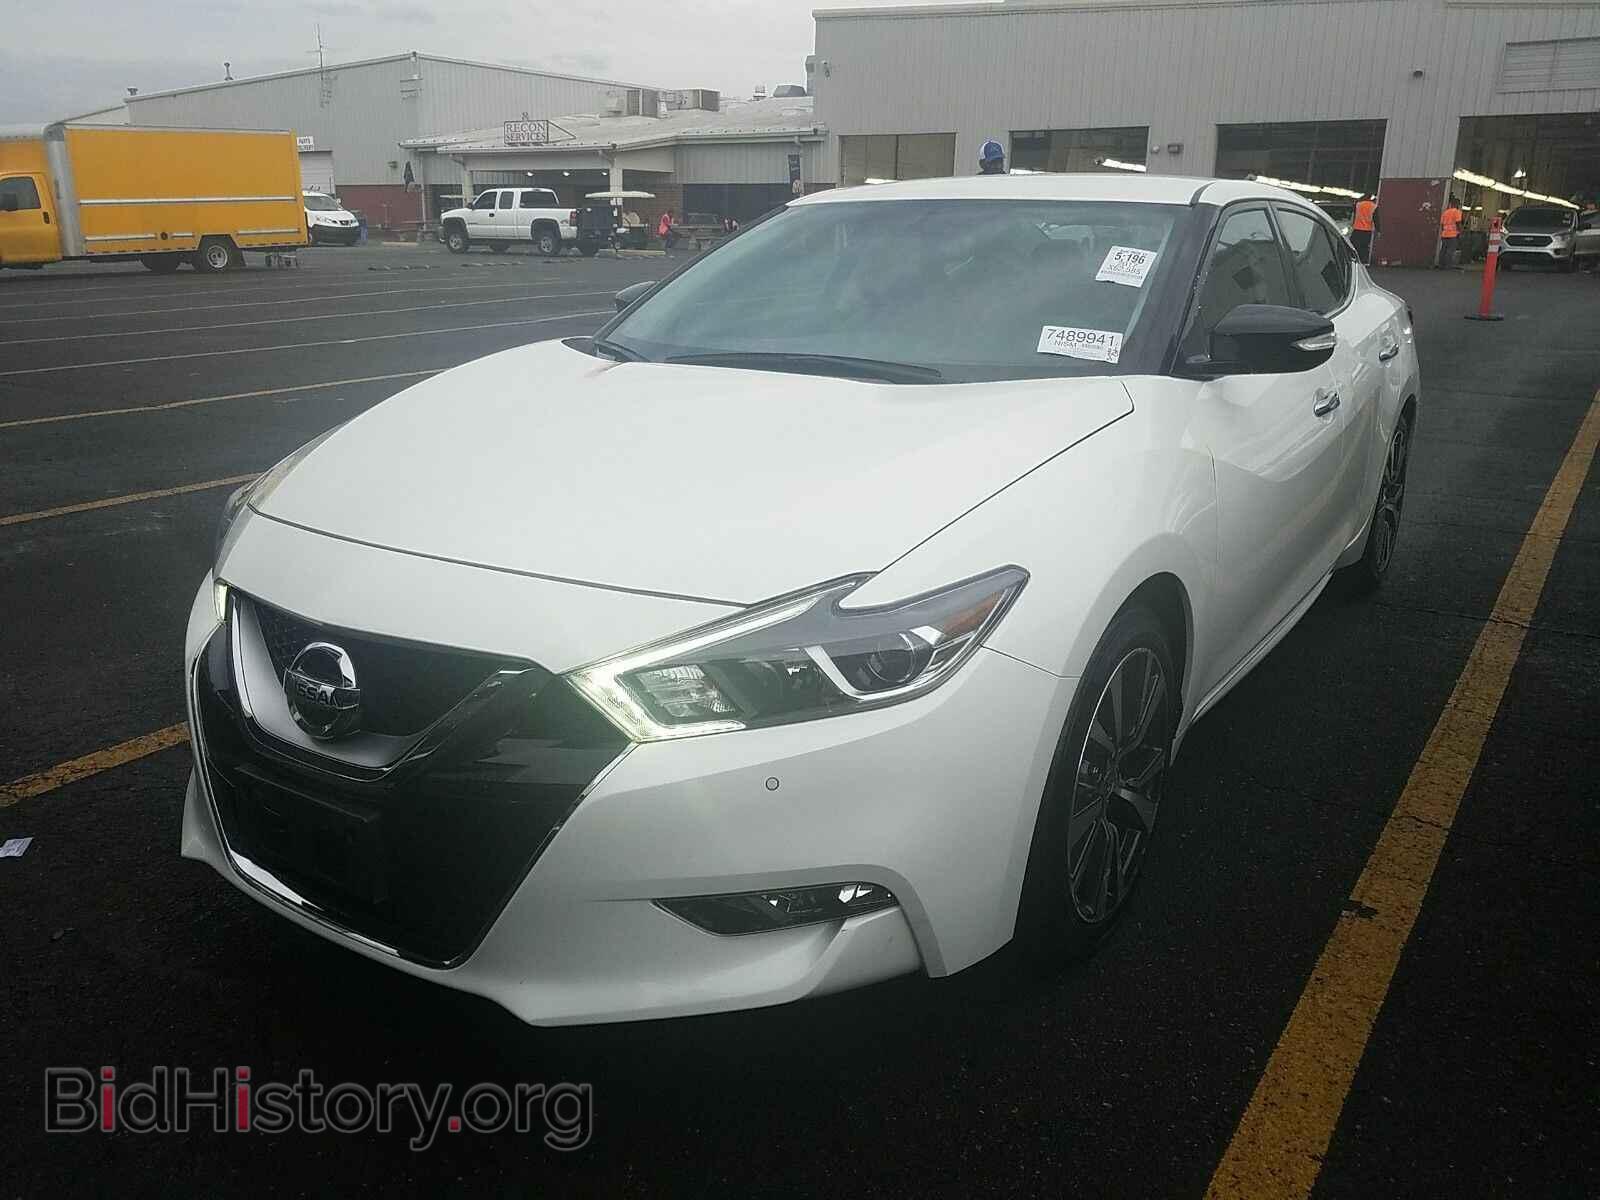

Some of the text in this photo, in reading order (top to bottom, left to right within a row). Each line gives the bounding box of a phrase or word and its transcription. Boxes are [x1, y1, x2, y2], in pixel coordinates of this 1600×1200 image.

[505, 122, 545, 133] RECON
[505, 132, 546, 142] SERVICES
[1047, 328, 1115, 347] 7489941
